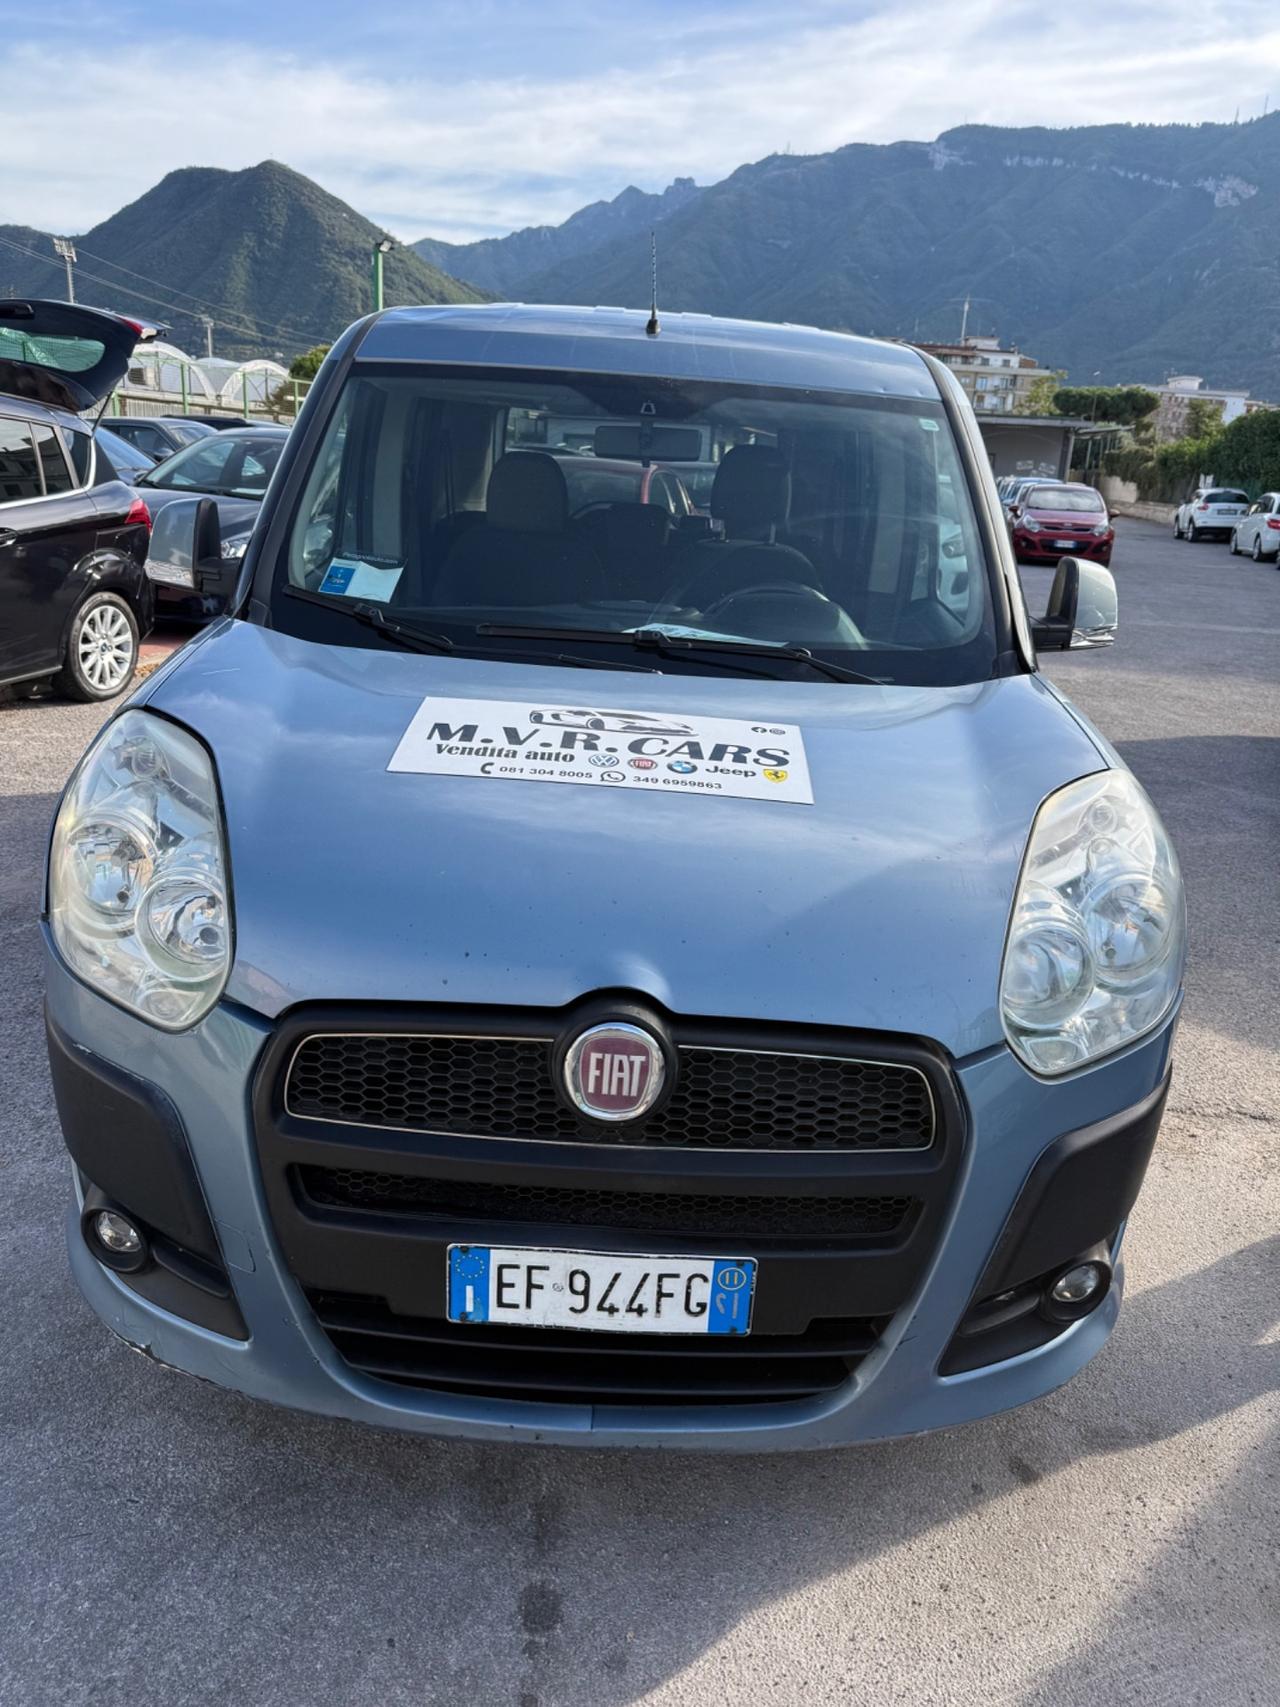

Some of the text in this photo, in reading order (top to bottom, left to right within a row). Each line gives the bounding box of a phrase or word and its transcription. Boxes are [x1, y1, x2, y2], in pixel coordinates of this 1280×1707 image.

[436, 743, 576, 763] Vendita auto
[499, 766, 525, 774] 081
[529, 768, 554, 776] 304
[705, 765, 757, 778] Jeep
[633, 775, 659, 784] 349
[587, 1052, 646, 1097] FIAT
[496, 1263, 549, 1310] EF
[568, 1268, 710, 1318] 944FG
